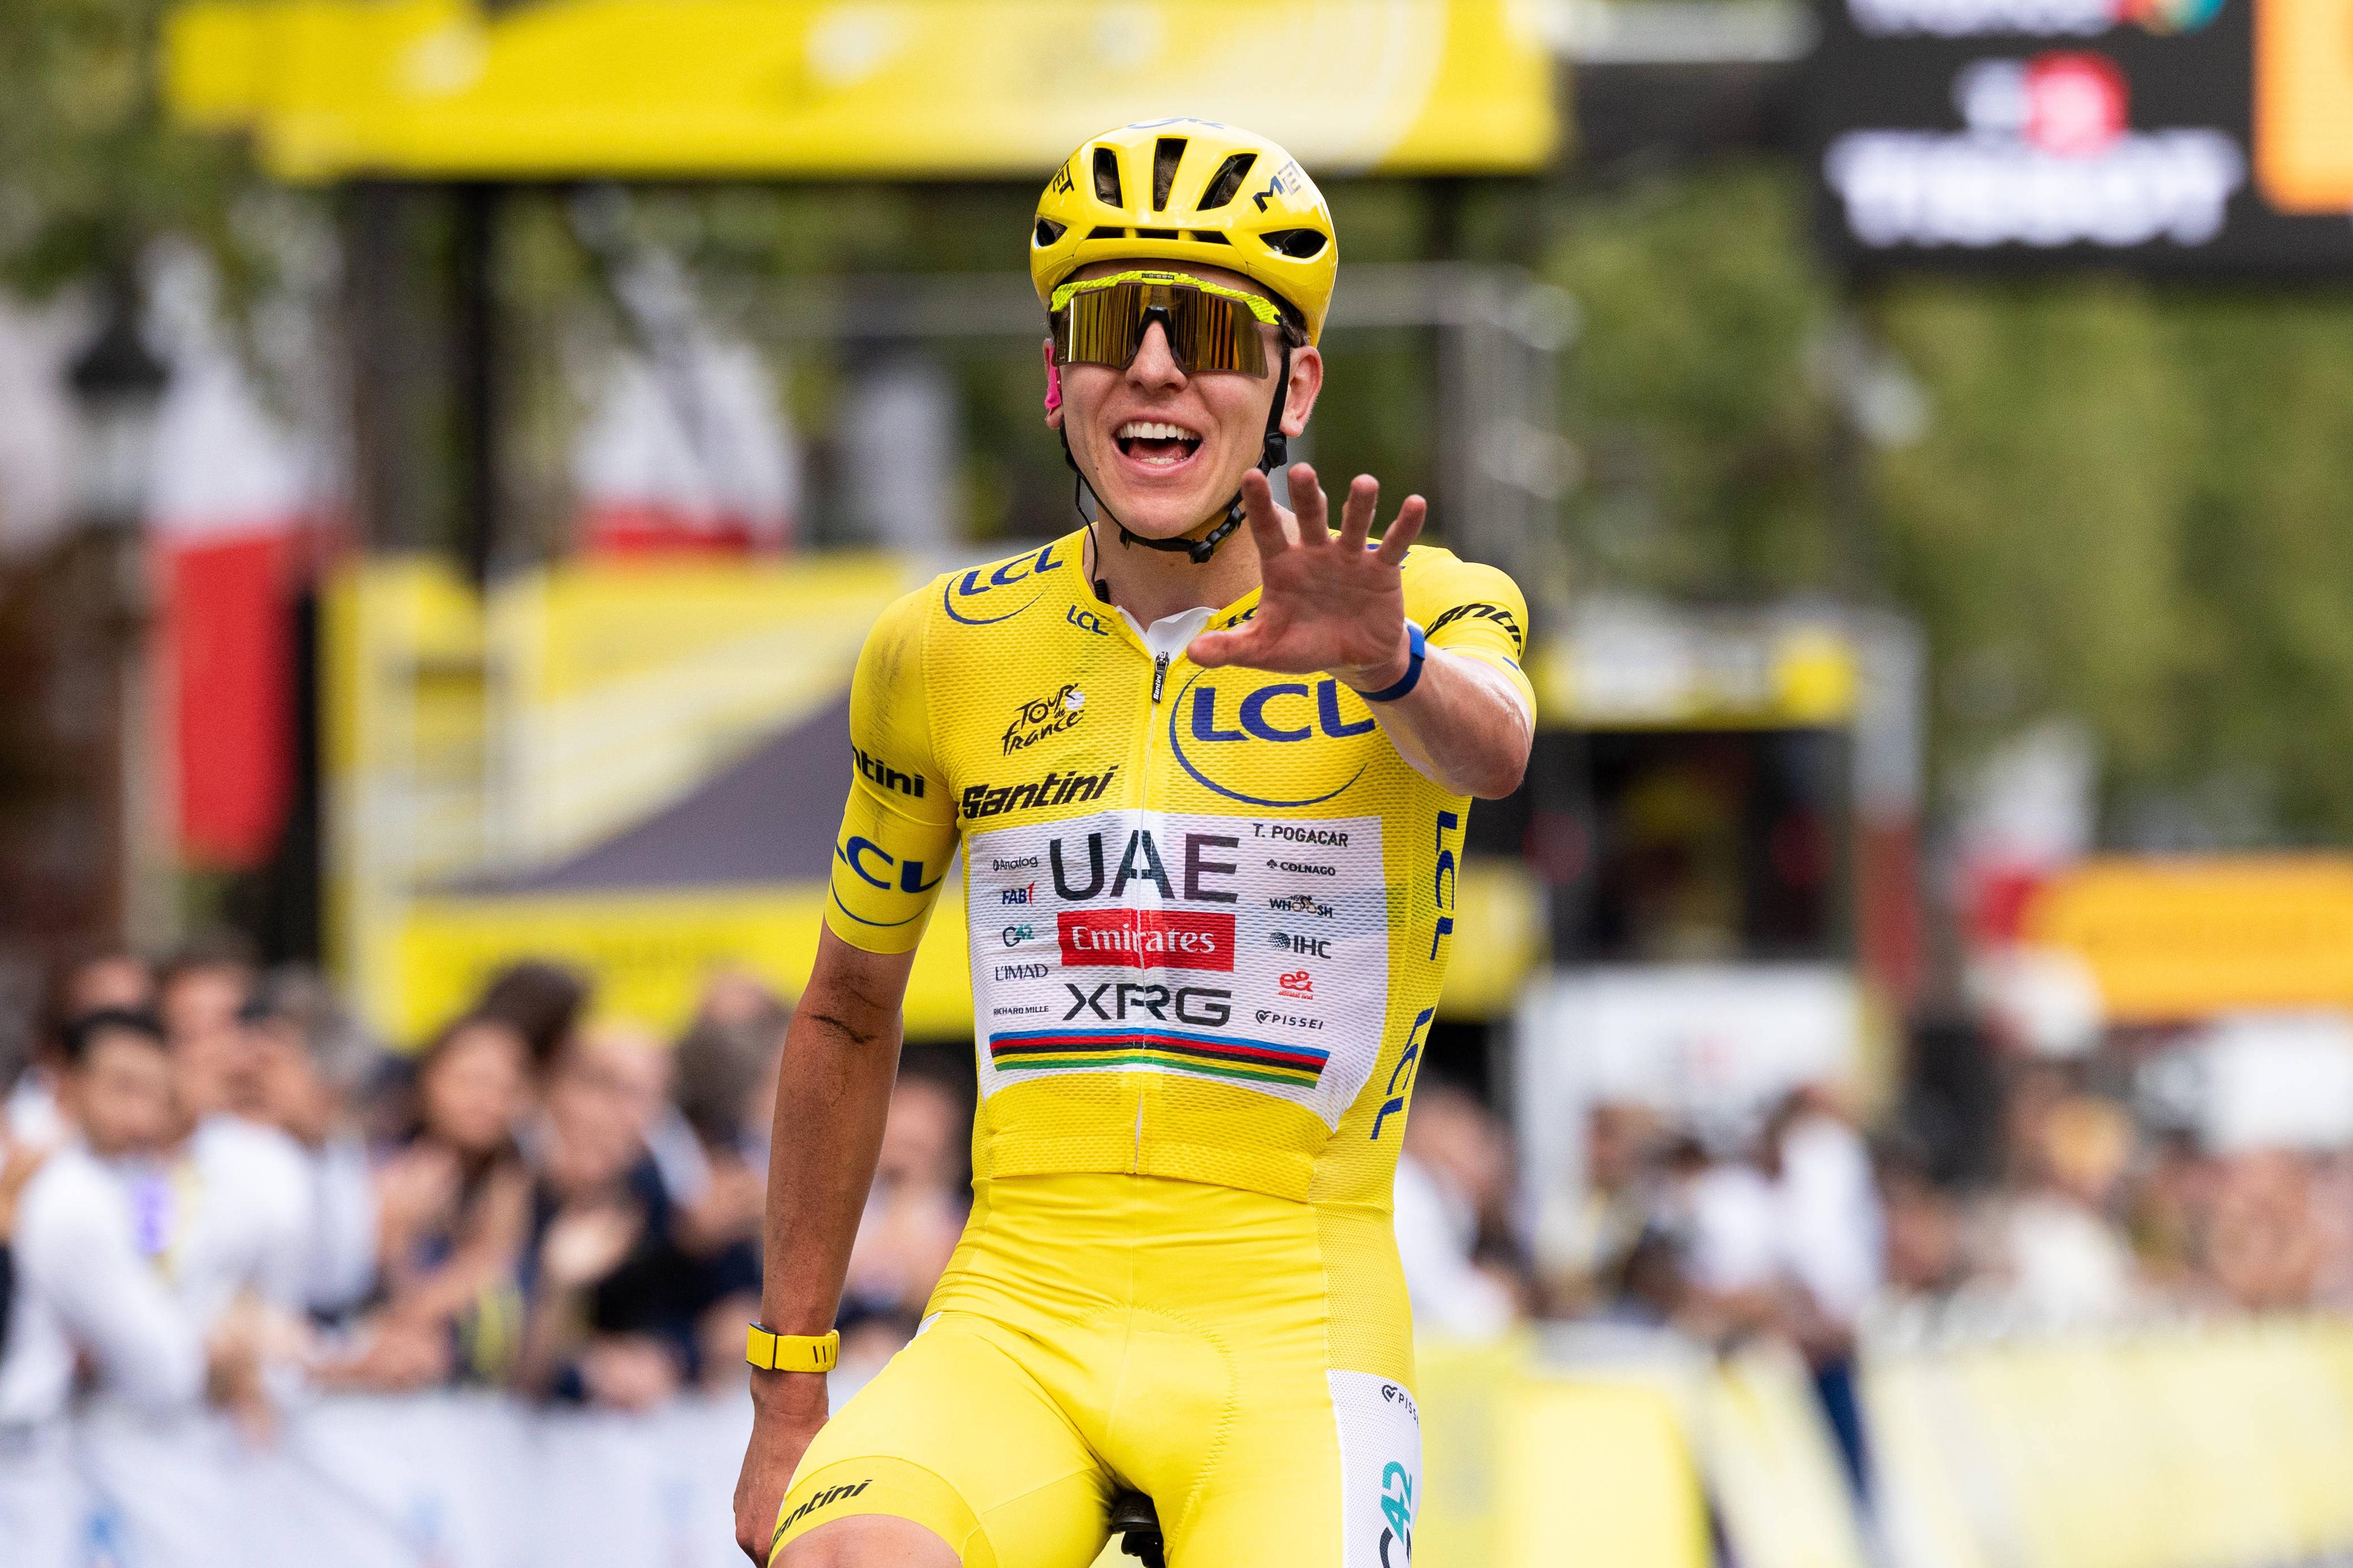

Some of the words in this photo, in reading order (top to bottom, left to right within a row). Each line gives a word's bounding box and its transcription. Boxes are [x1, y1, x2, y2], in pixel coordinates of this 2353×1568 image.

[1052, 158, 1075, 196] ET
[959, 545, 1063, 596] LCL
[1067, 605, 1108, 635] LCL
[1227, 607, 1258, 628] LC
[1424, 603, 1521, 658] antin
[1055, 708, 1065, 718] de
[1191, 679, 1375, 741] LCL
[852, 746, 924, 798] ntini
[962, 765, 1119, 819] Santini
[1253, 823, 1265, 837] T.
[1272, 825, 1348, 847] POGACAR
[1000, 856, 1038, 870] Analog
[1049, 830, 1240, 903] UAE
[1280, 862, 1336, 876] COLNAGO
[1002, 888, 1027, 904] FAB
[1431, 810, 1458, 961] LCL
[1002, 925, 1035, 947] G42
[1072, 924, 1216, 953] Emirates
[1294, 935, 1331, 959] IHC
[993, 1007, 1023, 1016] RICHARD
[1062, 983, 1232, 1026] XRG
[1272, 1014, 1323, 1029] PISSEI
[1370, 1007, 1434, 1140] LCL
[1399, 1393, 1418, 1427] PISS
